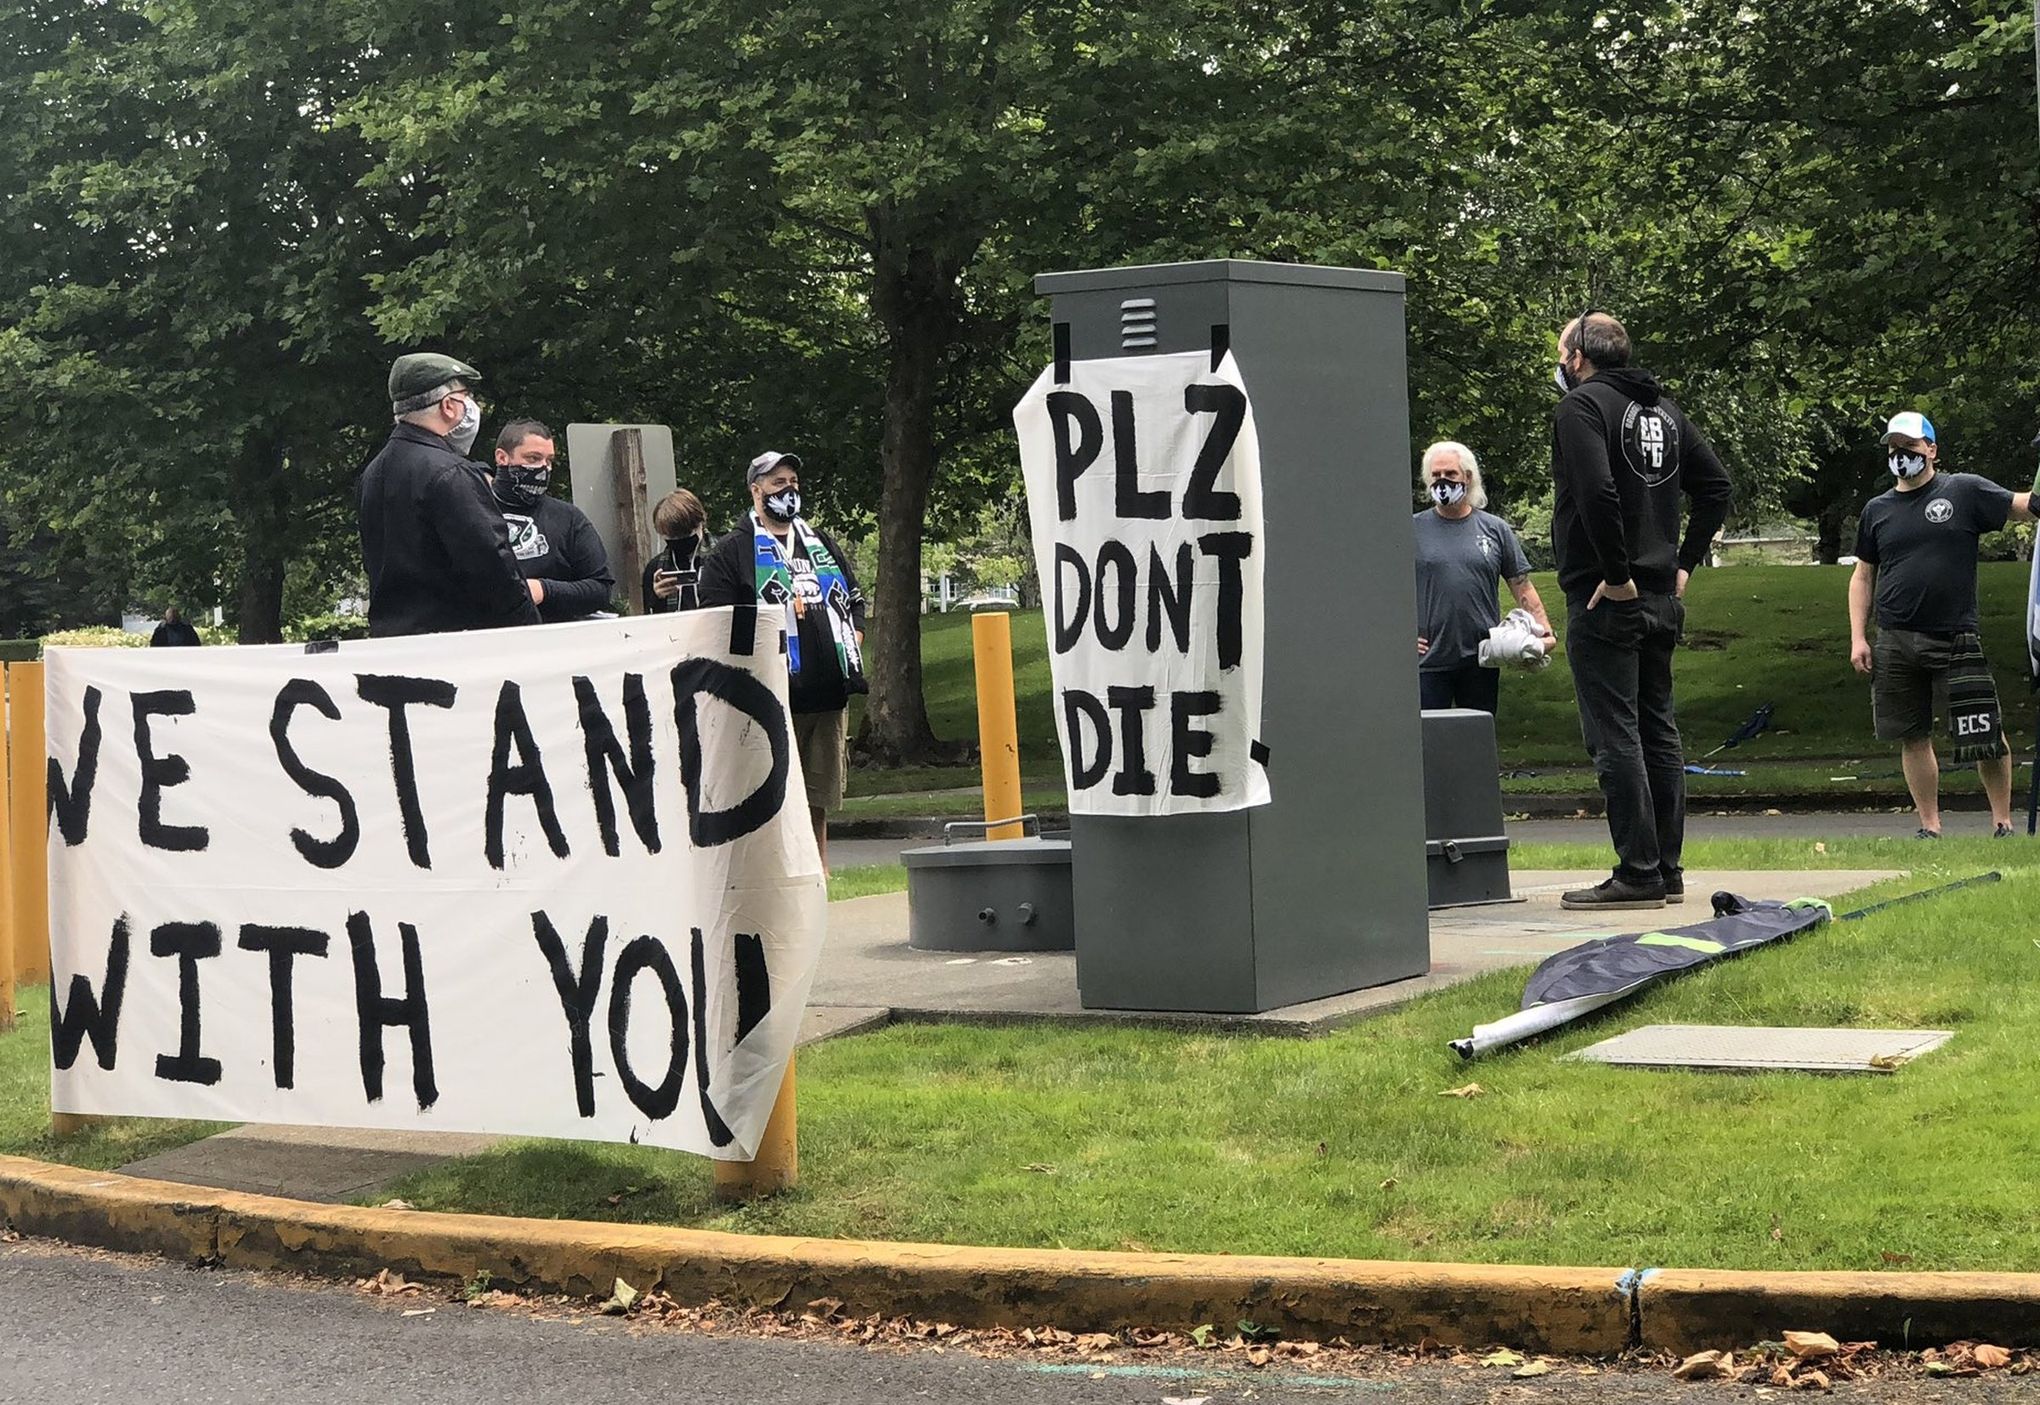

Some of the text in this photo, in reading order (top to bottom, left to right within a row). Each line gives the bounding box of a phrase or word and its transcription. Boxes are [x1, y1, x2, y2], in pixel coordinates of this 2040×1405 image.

[1046, 385, 1246, 521] PLZ
[1056, 532, 1253, 669] DONT
[270, 657, 790, 870] STAND
[1062, 686, 1222, 798] DIE
[1958, 713, 1990, 735] ECS
[50, 908, 770, 1147] WITH YOU
